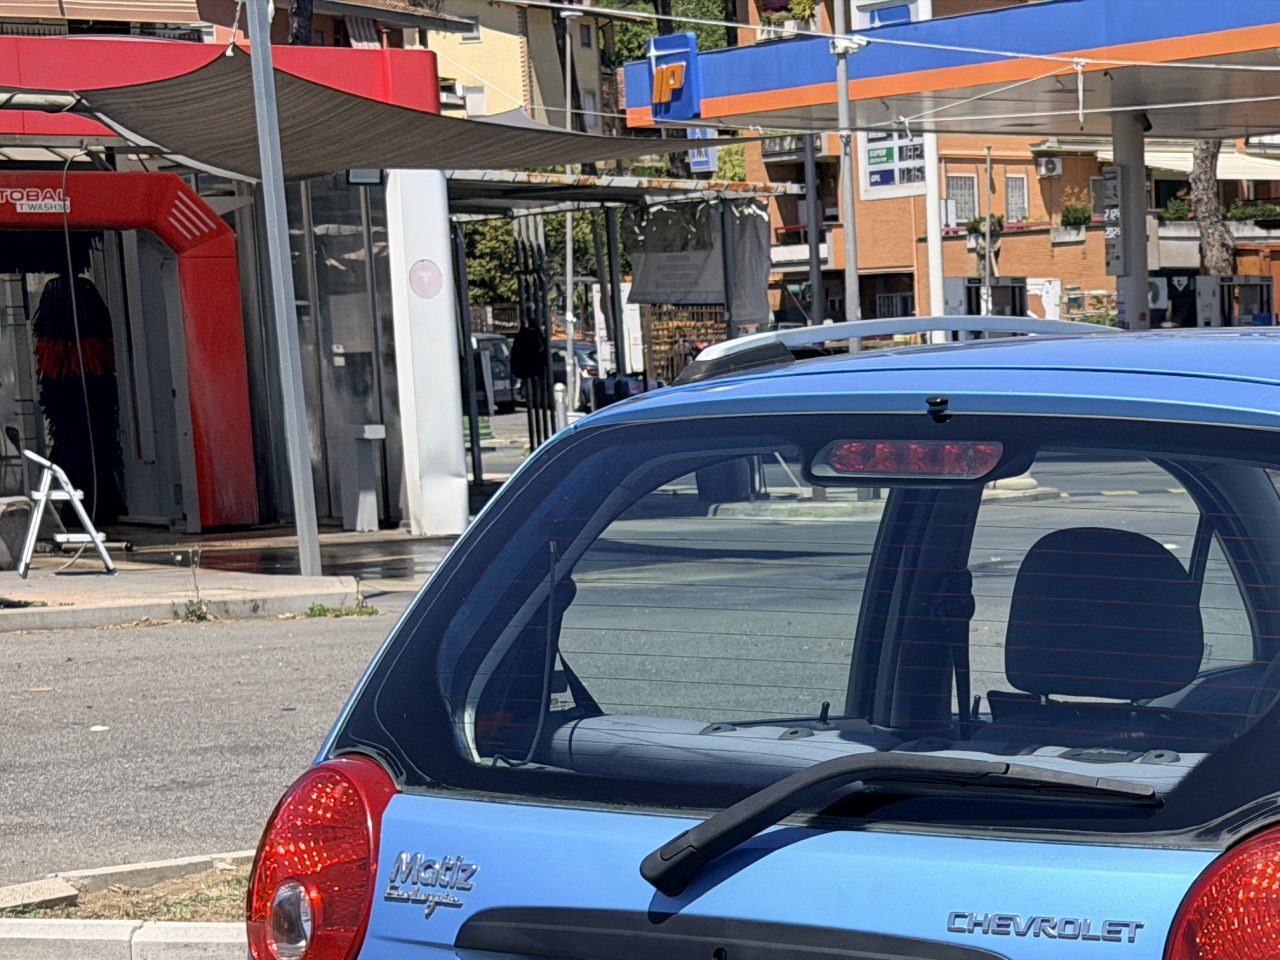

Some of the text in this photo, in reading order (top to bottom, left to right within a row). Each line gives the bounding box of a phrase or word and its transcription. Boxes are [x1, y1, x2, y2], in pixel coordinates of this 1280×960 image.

[652, 61, 686, 103] IP
[389, 850, 480, 891] Matiz
[946, 911, 1145, 944] CHEVROLET
